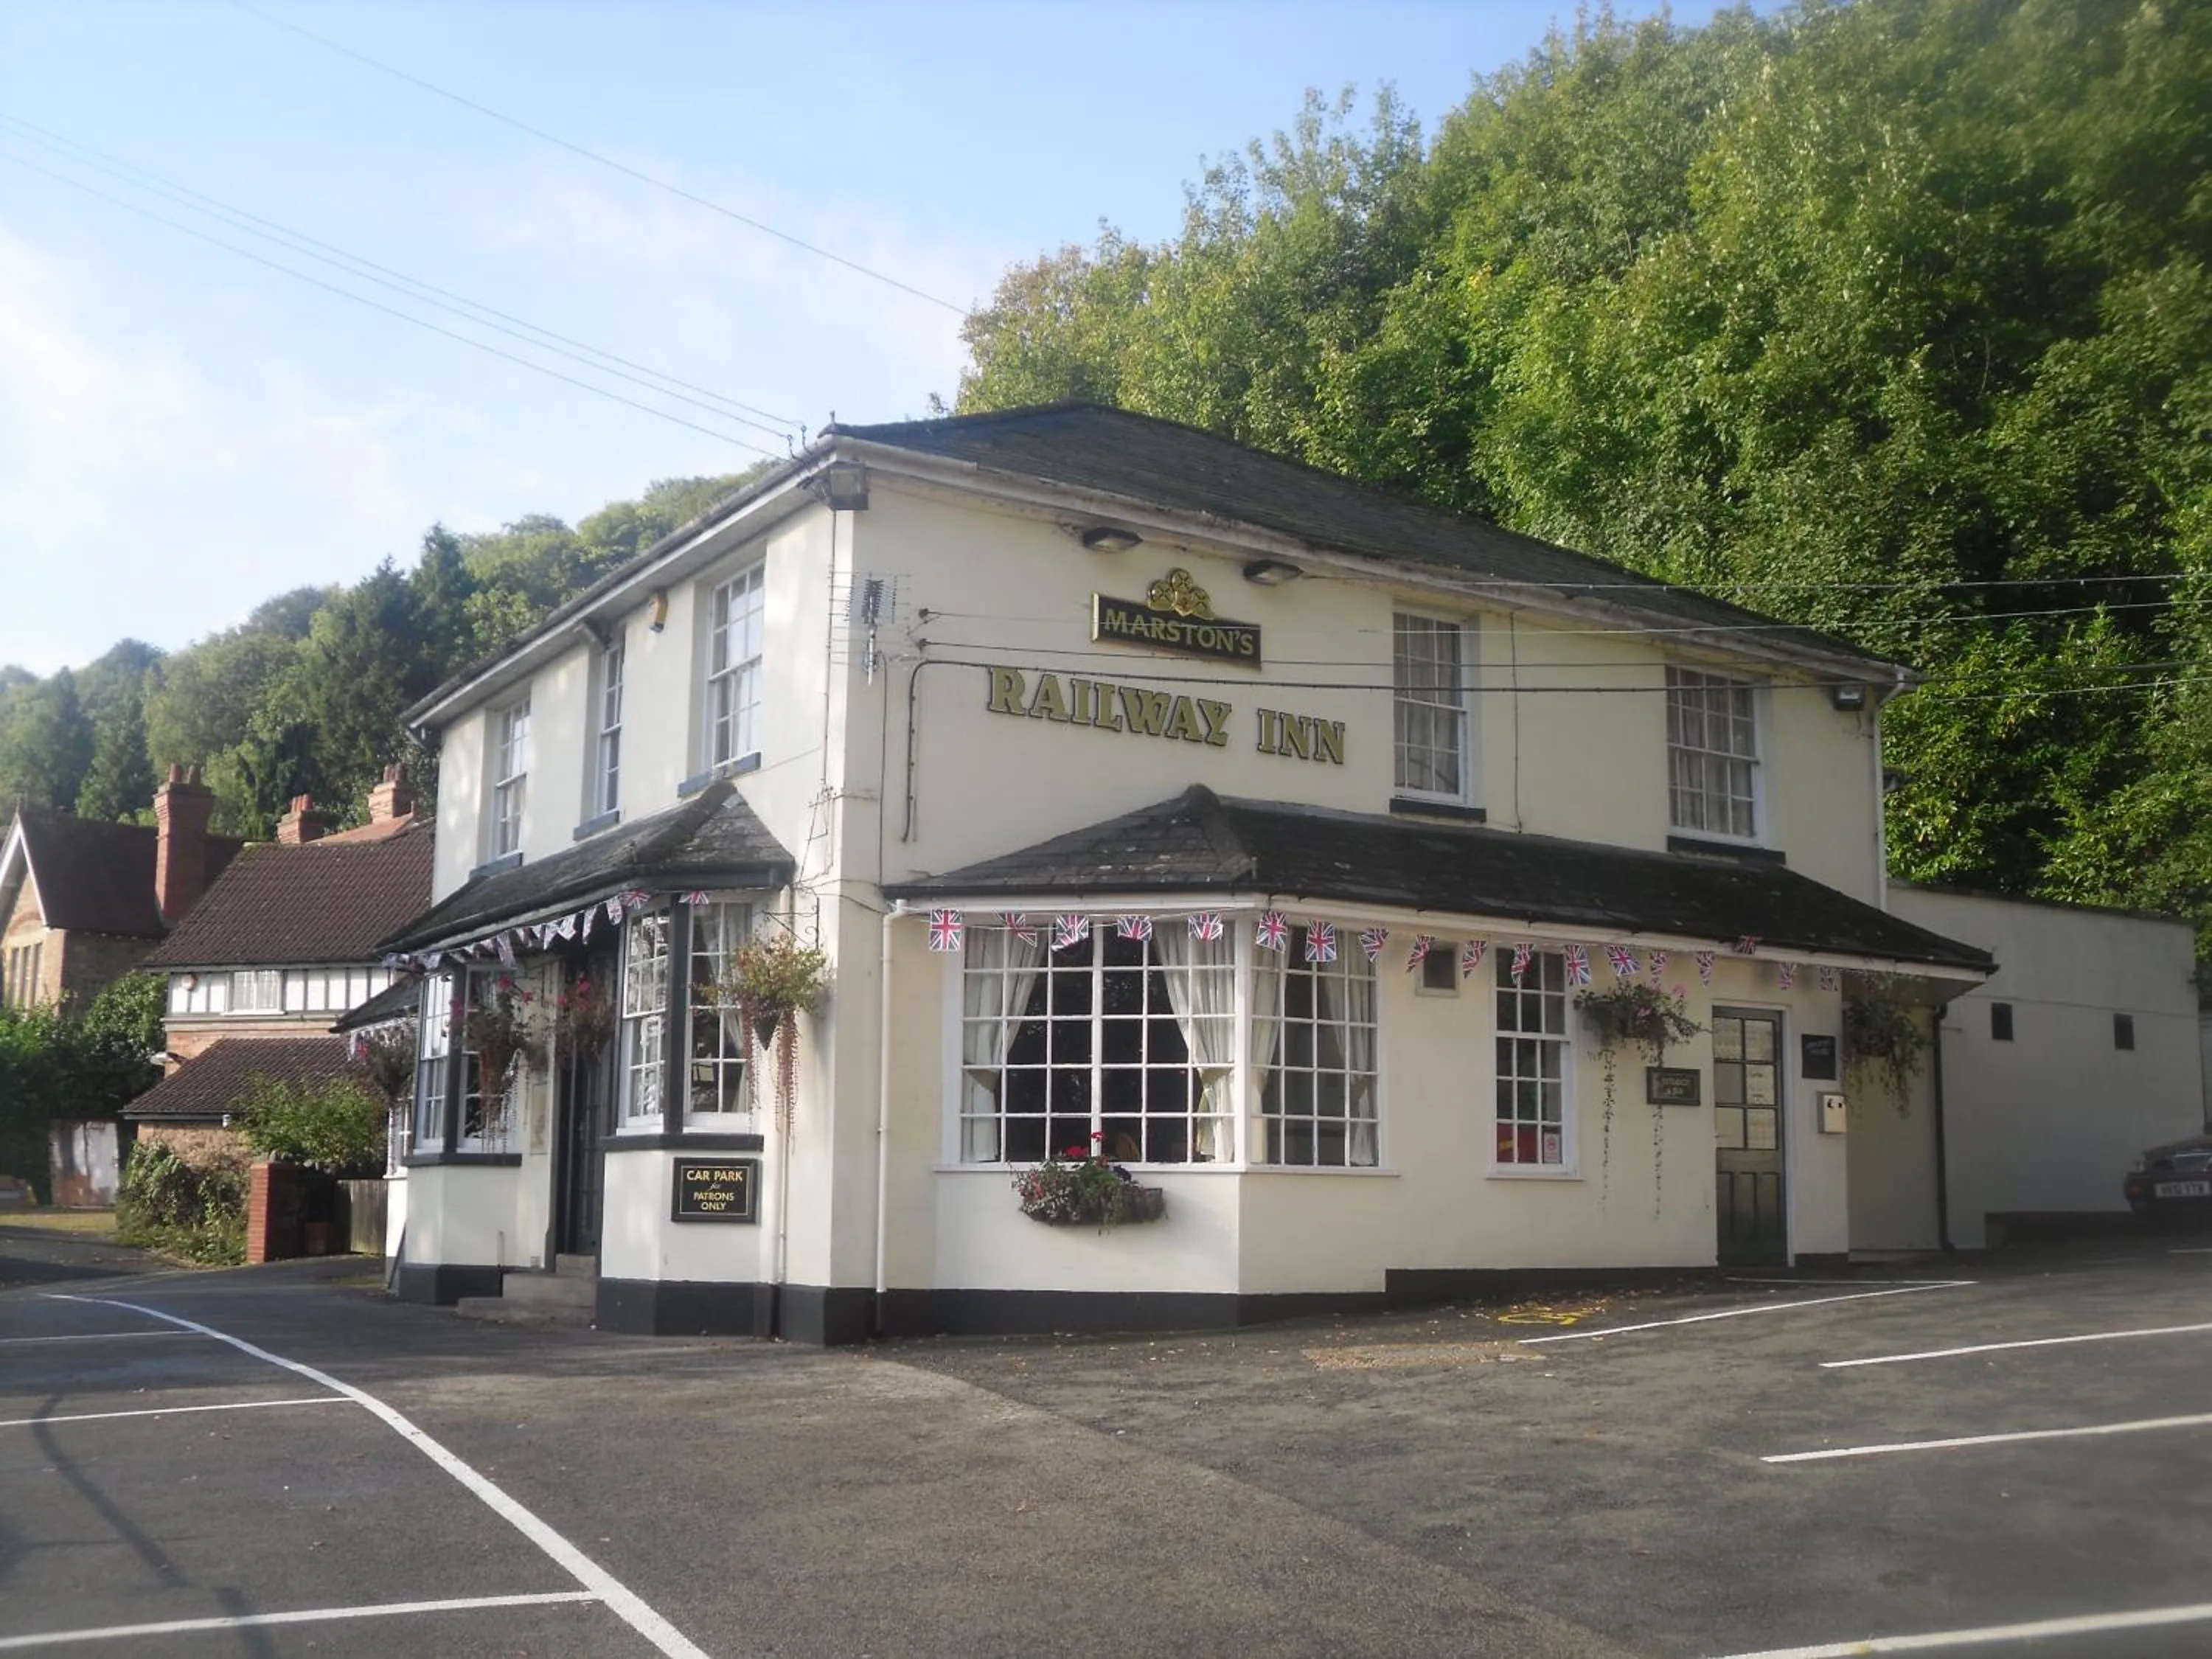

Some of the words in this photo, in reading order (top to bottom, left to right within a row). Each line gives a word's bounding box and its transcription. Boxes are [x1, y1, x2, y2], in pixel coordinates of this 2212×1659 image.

[1105, 608, 1253, 655] MARSTON'S
[987, 666, 1233, 746] RAILWAY
[1256, 708, 1346, 764] INN
[686, 1170, 710, 1180] CAR
[714, 1170, 742, 1181] PARK
[694, 1192, 735, 1201] PATRONS
[700, 1202, 726, 1210] ONLY
